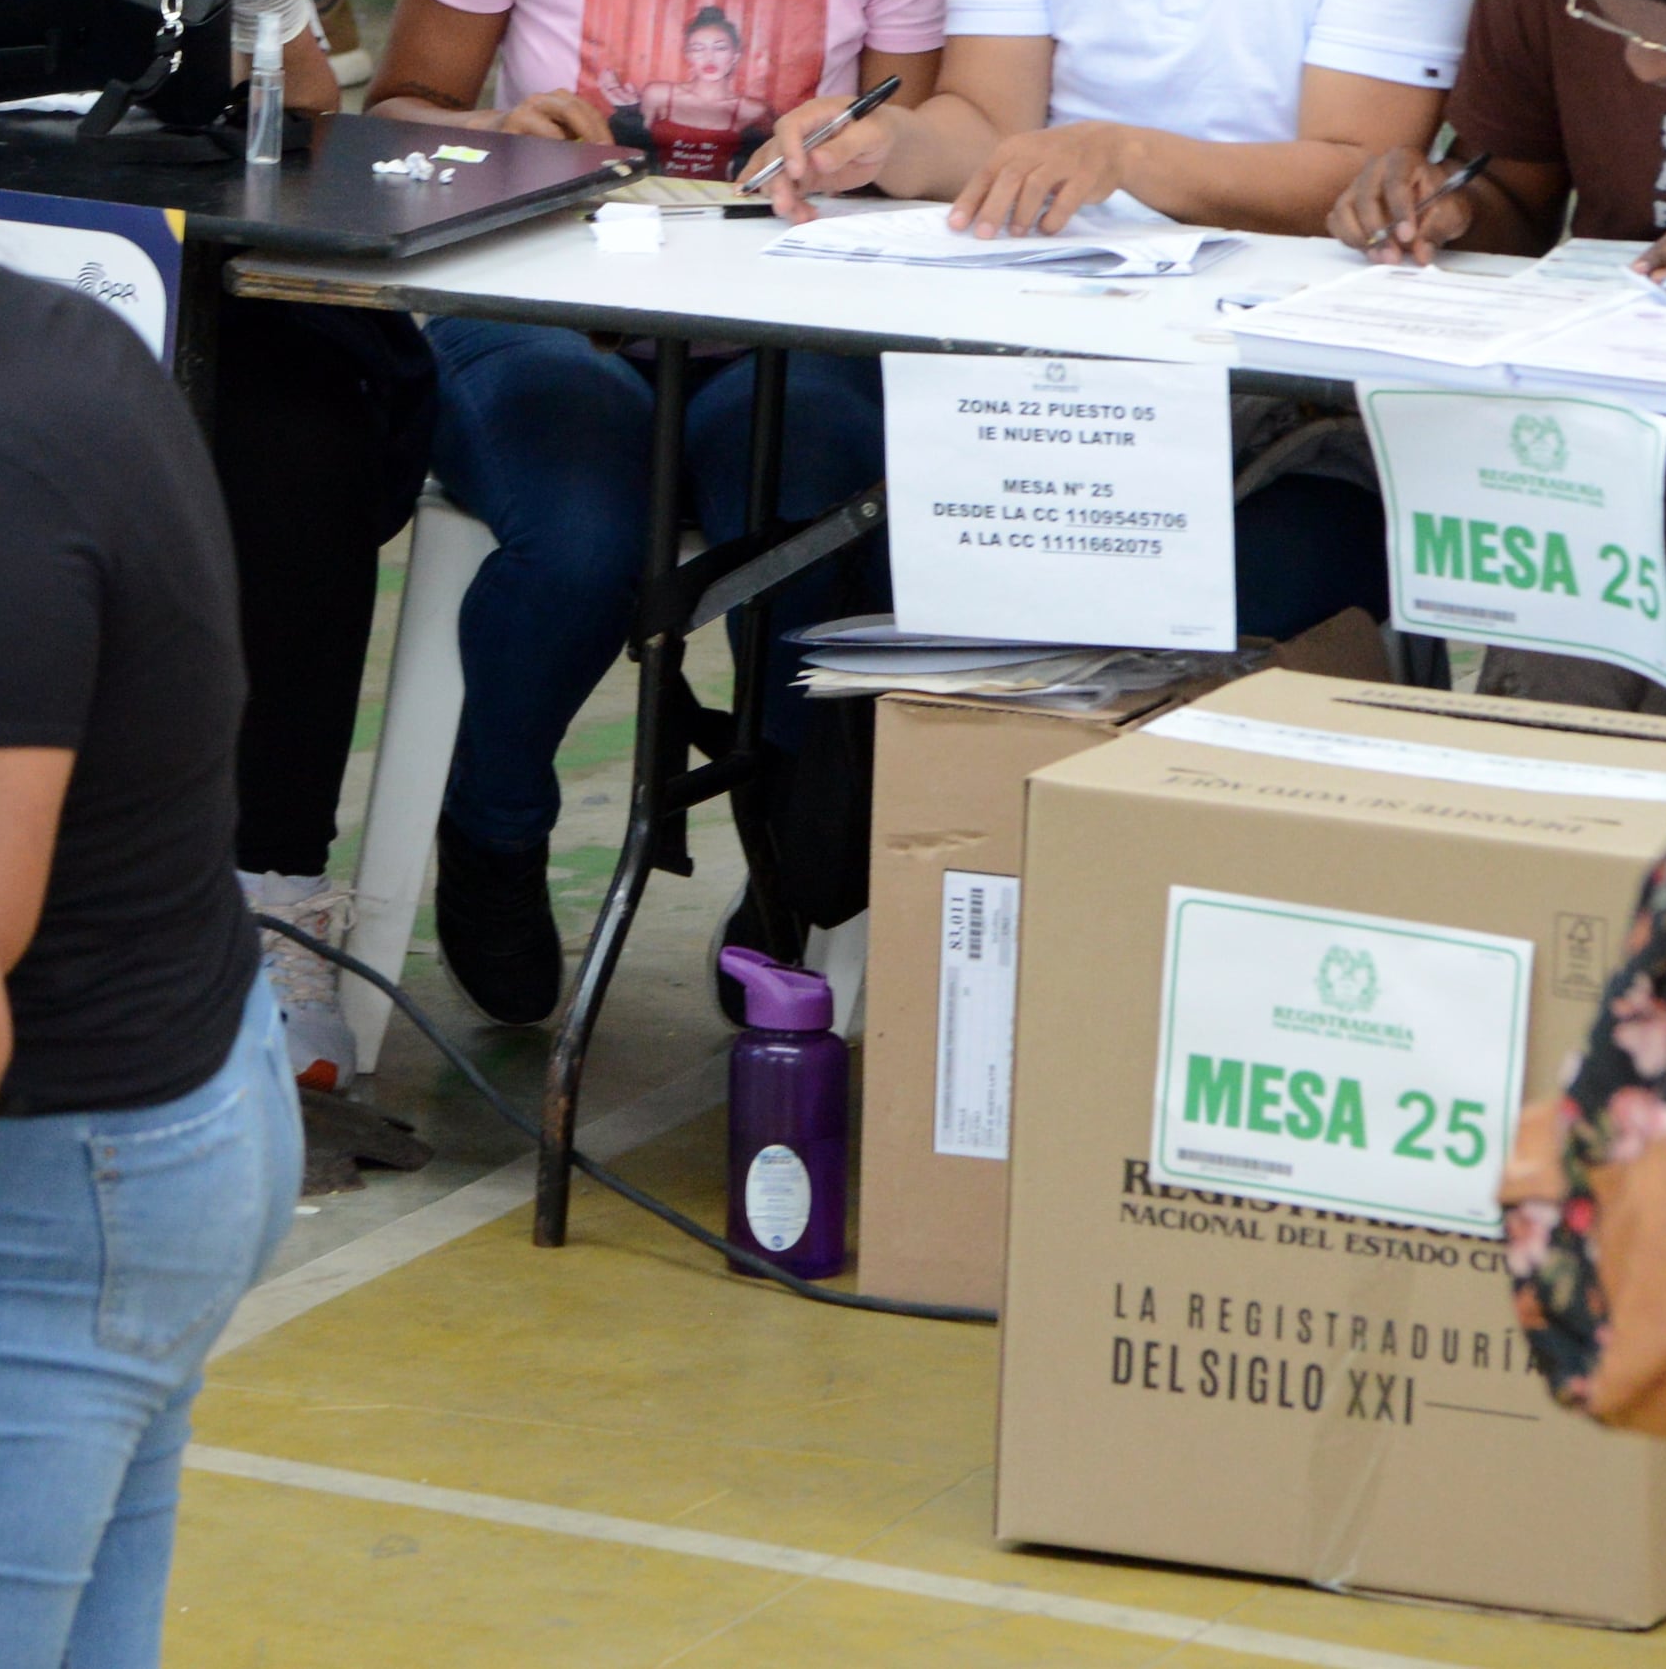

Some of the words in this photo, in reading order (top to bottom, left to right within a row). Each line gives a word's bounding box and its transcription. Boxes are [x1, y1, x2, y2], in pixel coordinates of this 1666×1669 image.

[957, 398, 1011, 415] ZONA
[1018, 401, 1042, 417] 22
[1048, 403, 1126, 420] PUESTO
[1132, 406, 1156, 421] 05
[978, 426, 997, 441] IE
[1004, 427, 1072, 444] NUEVO
[1079, 431, 1136, 447] LATIR
[1003, 479, 1056, 496] MESA
[1091, 483, 1114, 498] 25
[933, 503, 995, 520] DESDE
[1002, 506, 1027, 522] LA
[1033, 507, 1060, 523] CC
[959, 532, 972, 546] A
[978, 532, 1002, 547] LA
[1009, 533, 1035, 549] CC
[1412, 511, 1580, 597] MESA
[1598, 543, 1661, 620] 25
[1182, 1053, 1368, 1150] MESA
[1392, 1089, 1488, 1169] 25
[1119, 1202, 1265, 1241] NACIONAL
[1276, 1222, 1333, 1250] DEL
[1344, 1232, 1459, 1267] ESTADO
[1114, 1282, 1157, 1323] LA
[1111, 1336, 1184, 1394] DEL
[1199, 1347, 1324, 1413] SIGLO
[1345, 1370, 1416, 1426] XXI
